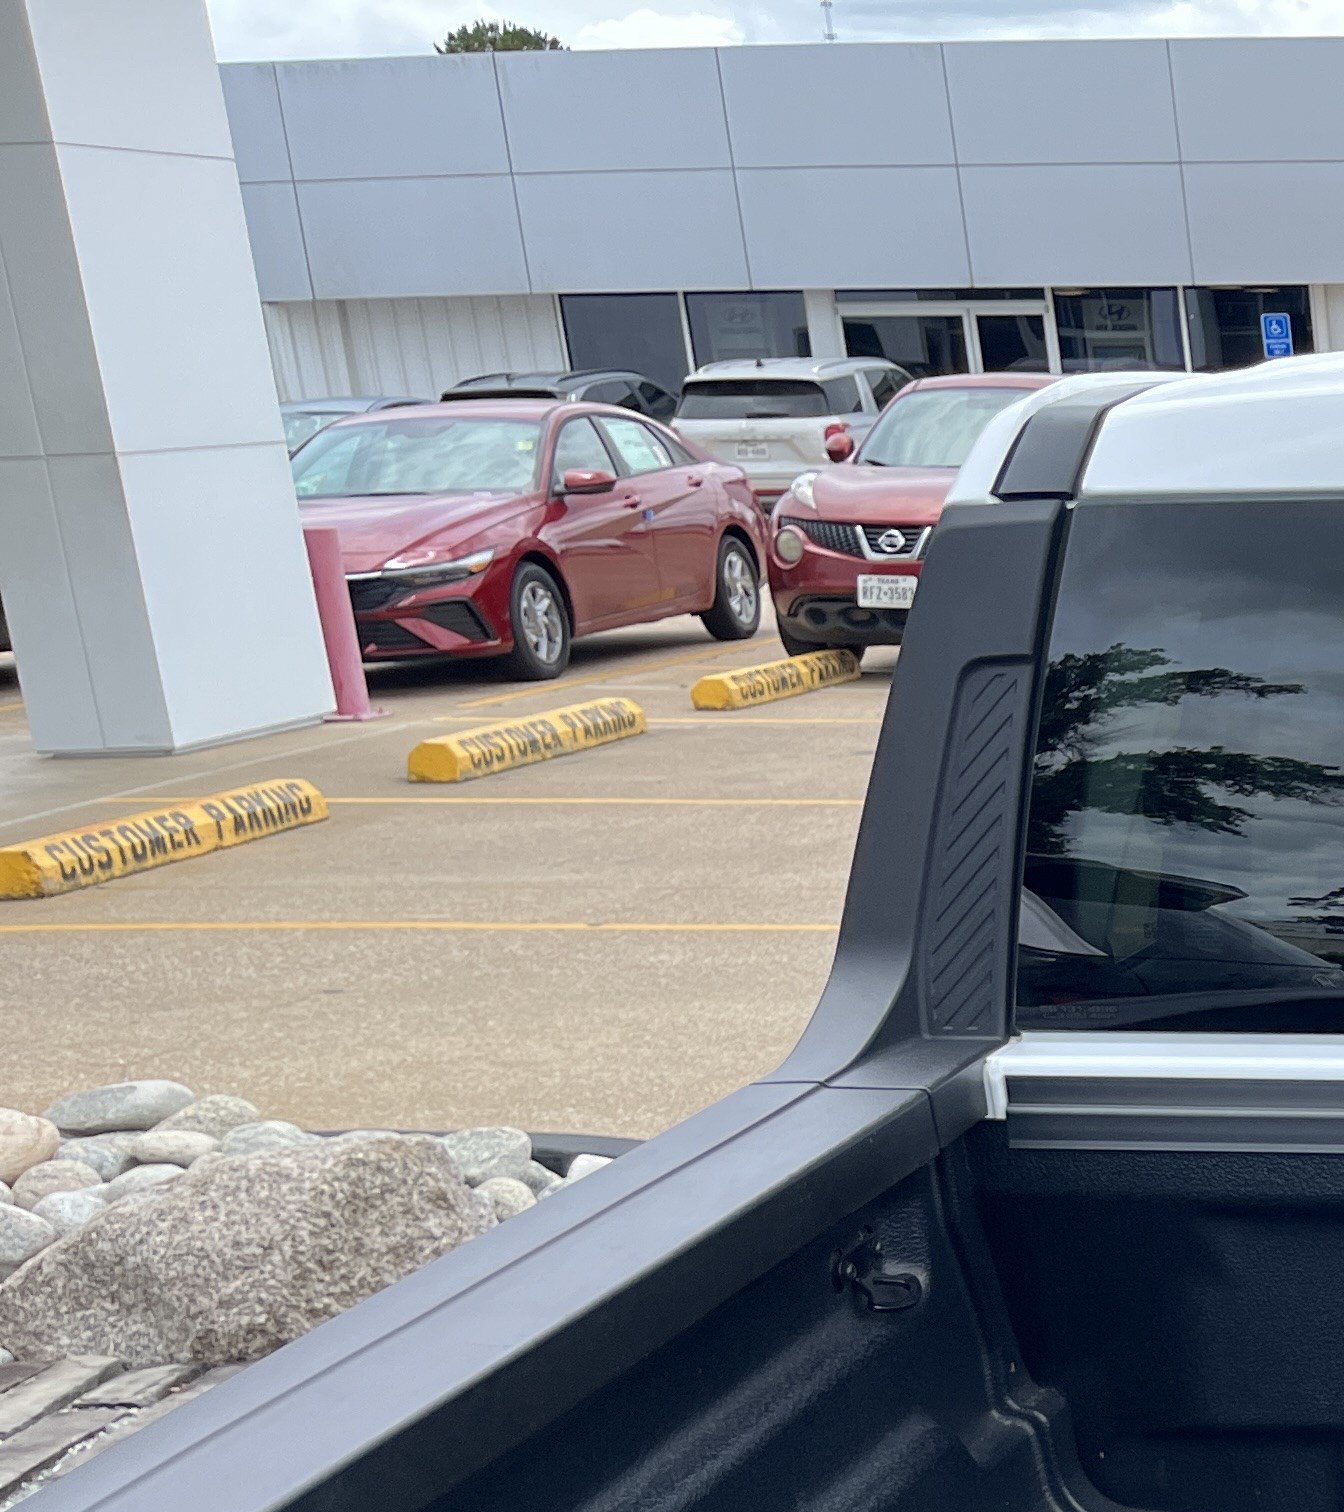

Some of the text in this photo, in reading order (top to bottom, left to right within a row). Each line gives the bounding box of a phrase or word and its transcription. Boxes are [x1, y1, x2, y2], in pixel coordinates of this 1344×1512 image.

[457, 701, 636, 769] CUSTOMER PARKING
[44, 782, 312, 882] CUSTOMER PARKING
